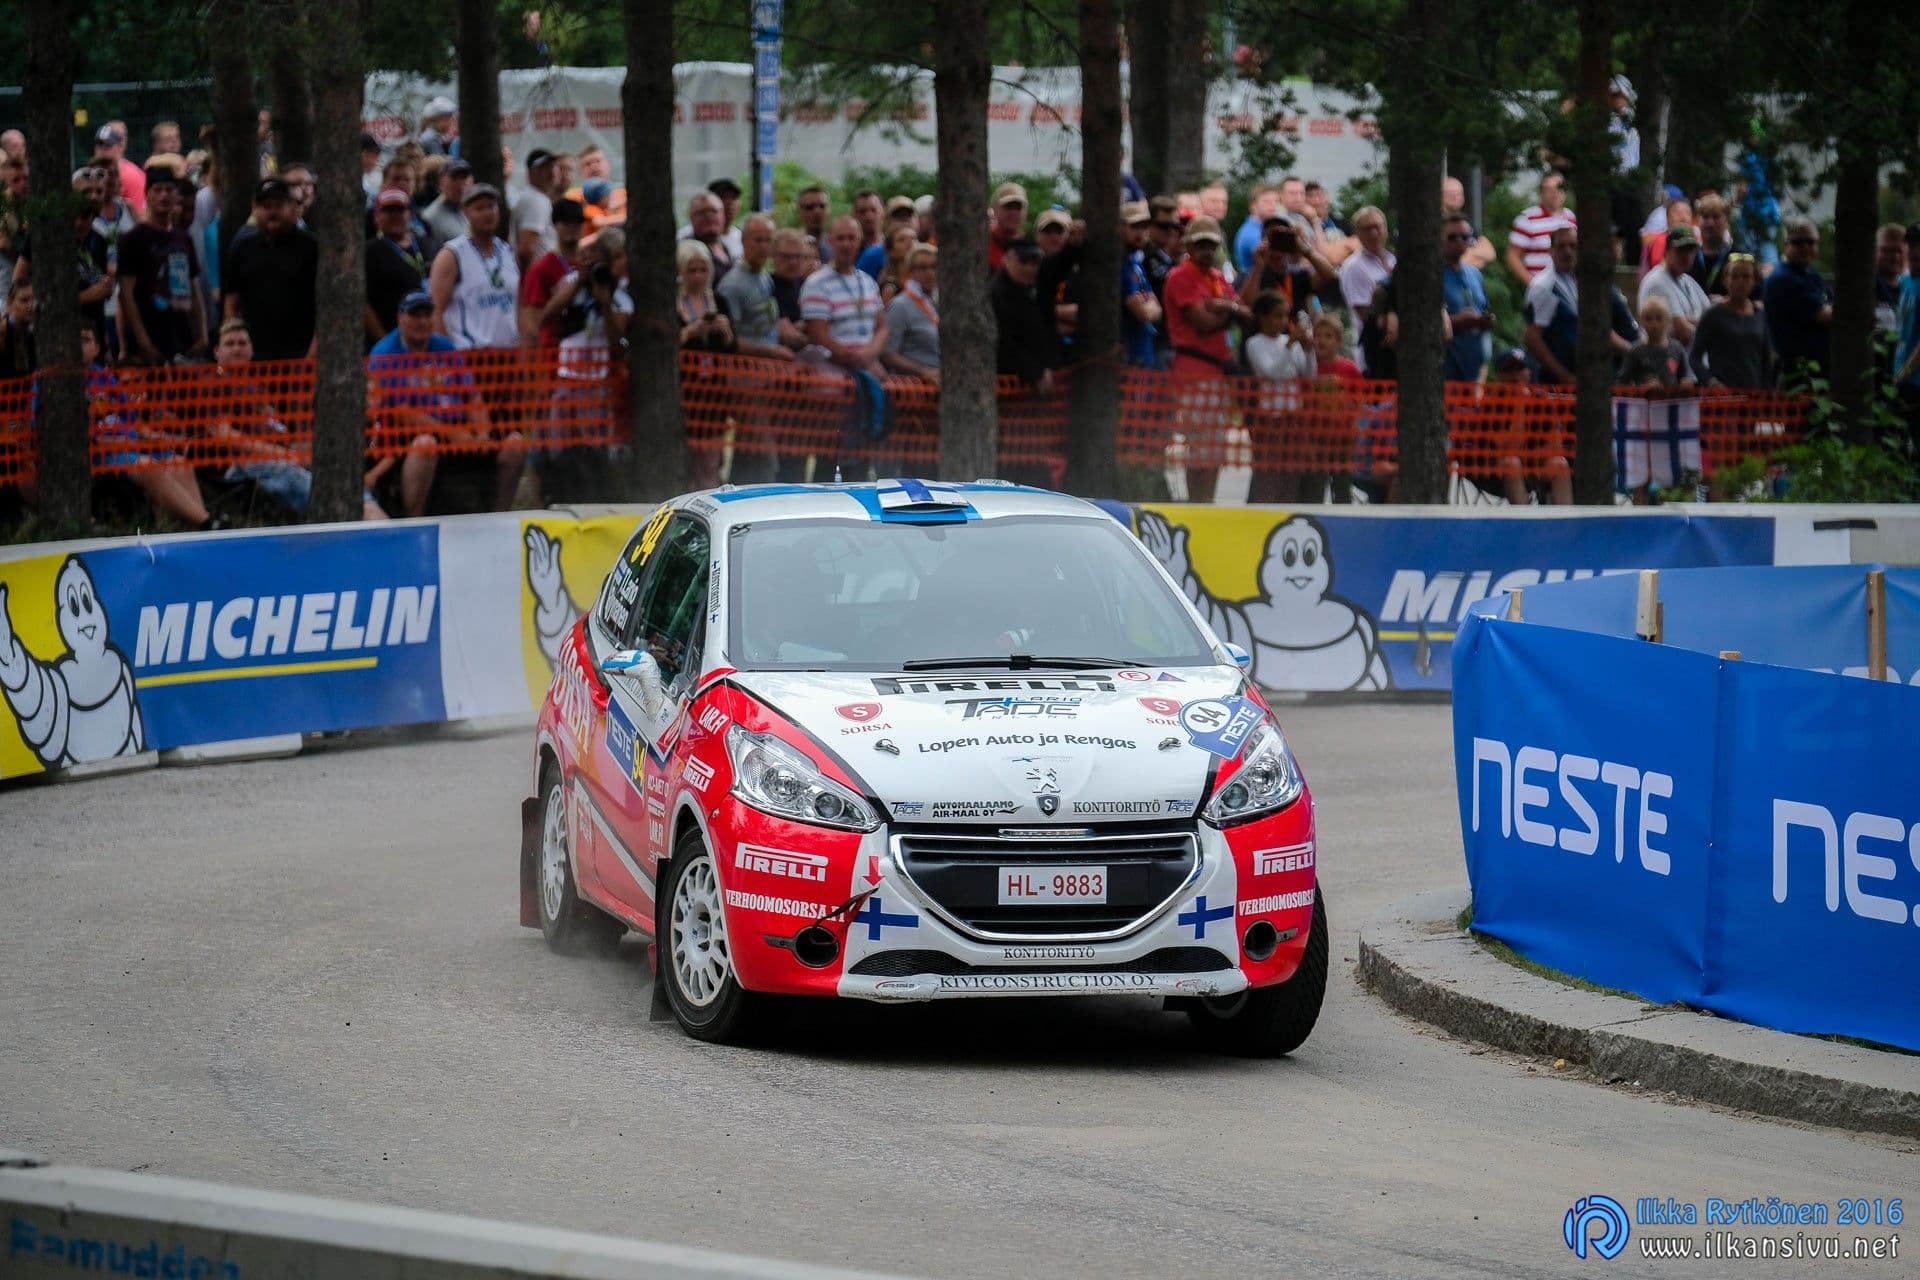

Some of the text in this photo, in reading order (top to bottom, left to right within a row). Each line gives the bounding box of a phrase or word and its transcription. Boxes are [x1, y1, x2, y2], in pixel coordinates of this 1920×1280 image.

[134, 584, 437, 667] MICHELIN
[870, 674, 1117, 695] PIRELLI
[1190, 705, 1226, 727] 94
[1219, 706, 1257, 746] NESTE
[840, 723, 892, 736] SORSA
[919, 733, 1137, 753] Lopen Auto ja Rengas
[932, 801, 1014, 810] AUTOMAALAAMO
[932, 809, 996, 818] AIR-MAAL OY
[1073, 798, 1161, 813] KONTTORITYÖ
[1472, 737, 1673, 876] NESTE
[734, 842, 829, 882] PIRELLI
[1253, 842, 1314, 876] PIRELLI
[1773, 798, 1920, 928] NE
[1003, 946, 1095, 959] KONTTORITYÖ
[940, 974, 1160, 988] KIVICONSTRUCTION OY
